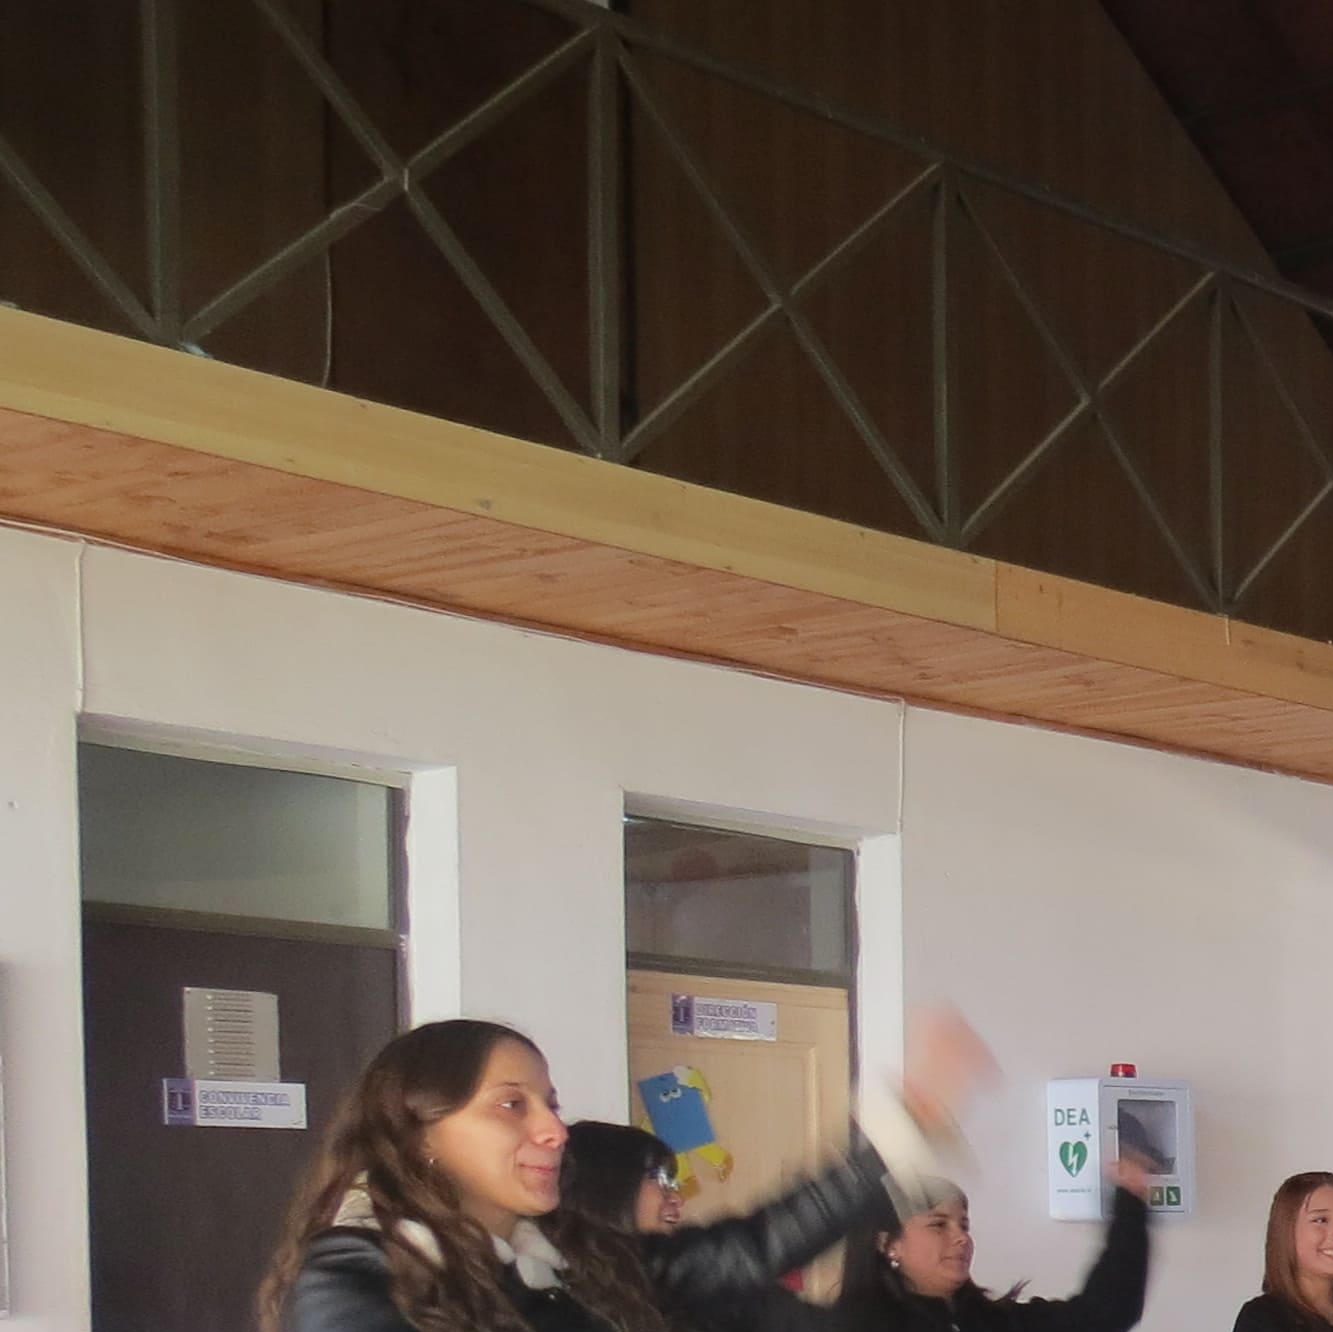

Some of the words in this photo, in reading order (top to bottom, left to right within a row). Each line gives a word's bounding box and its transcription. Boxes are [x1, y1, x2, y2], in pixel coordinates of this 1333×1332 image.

[200, 1089, 290, 1106] CONVIVENCIA
[200, 1105, 262, 1120] ESCOLAR
[1054, 1108, 1091, 1126] DEA
